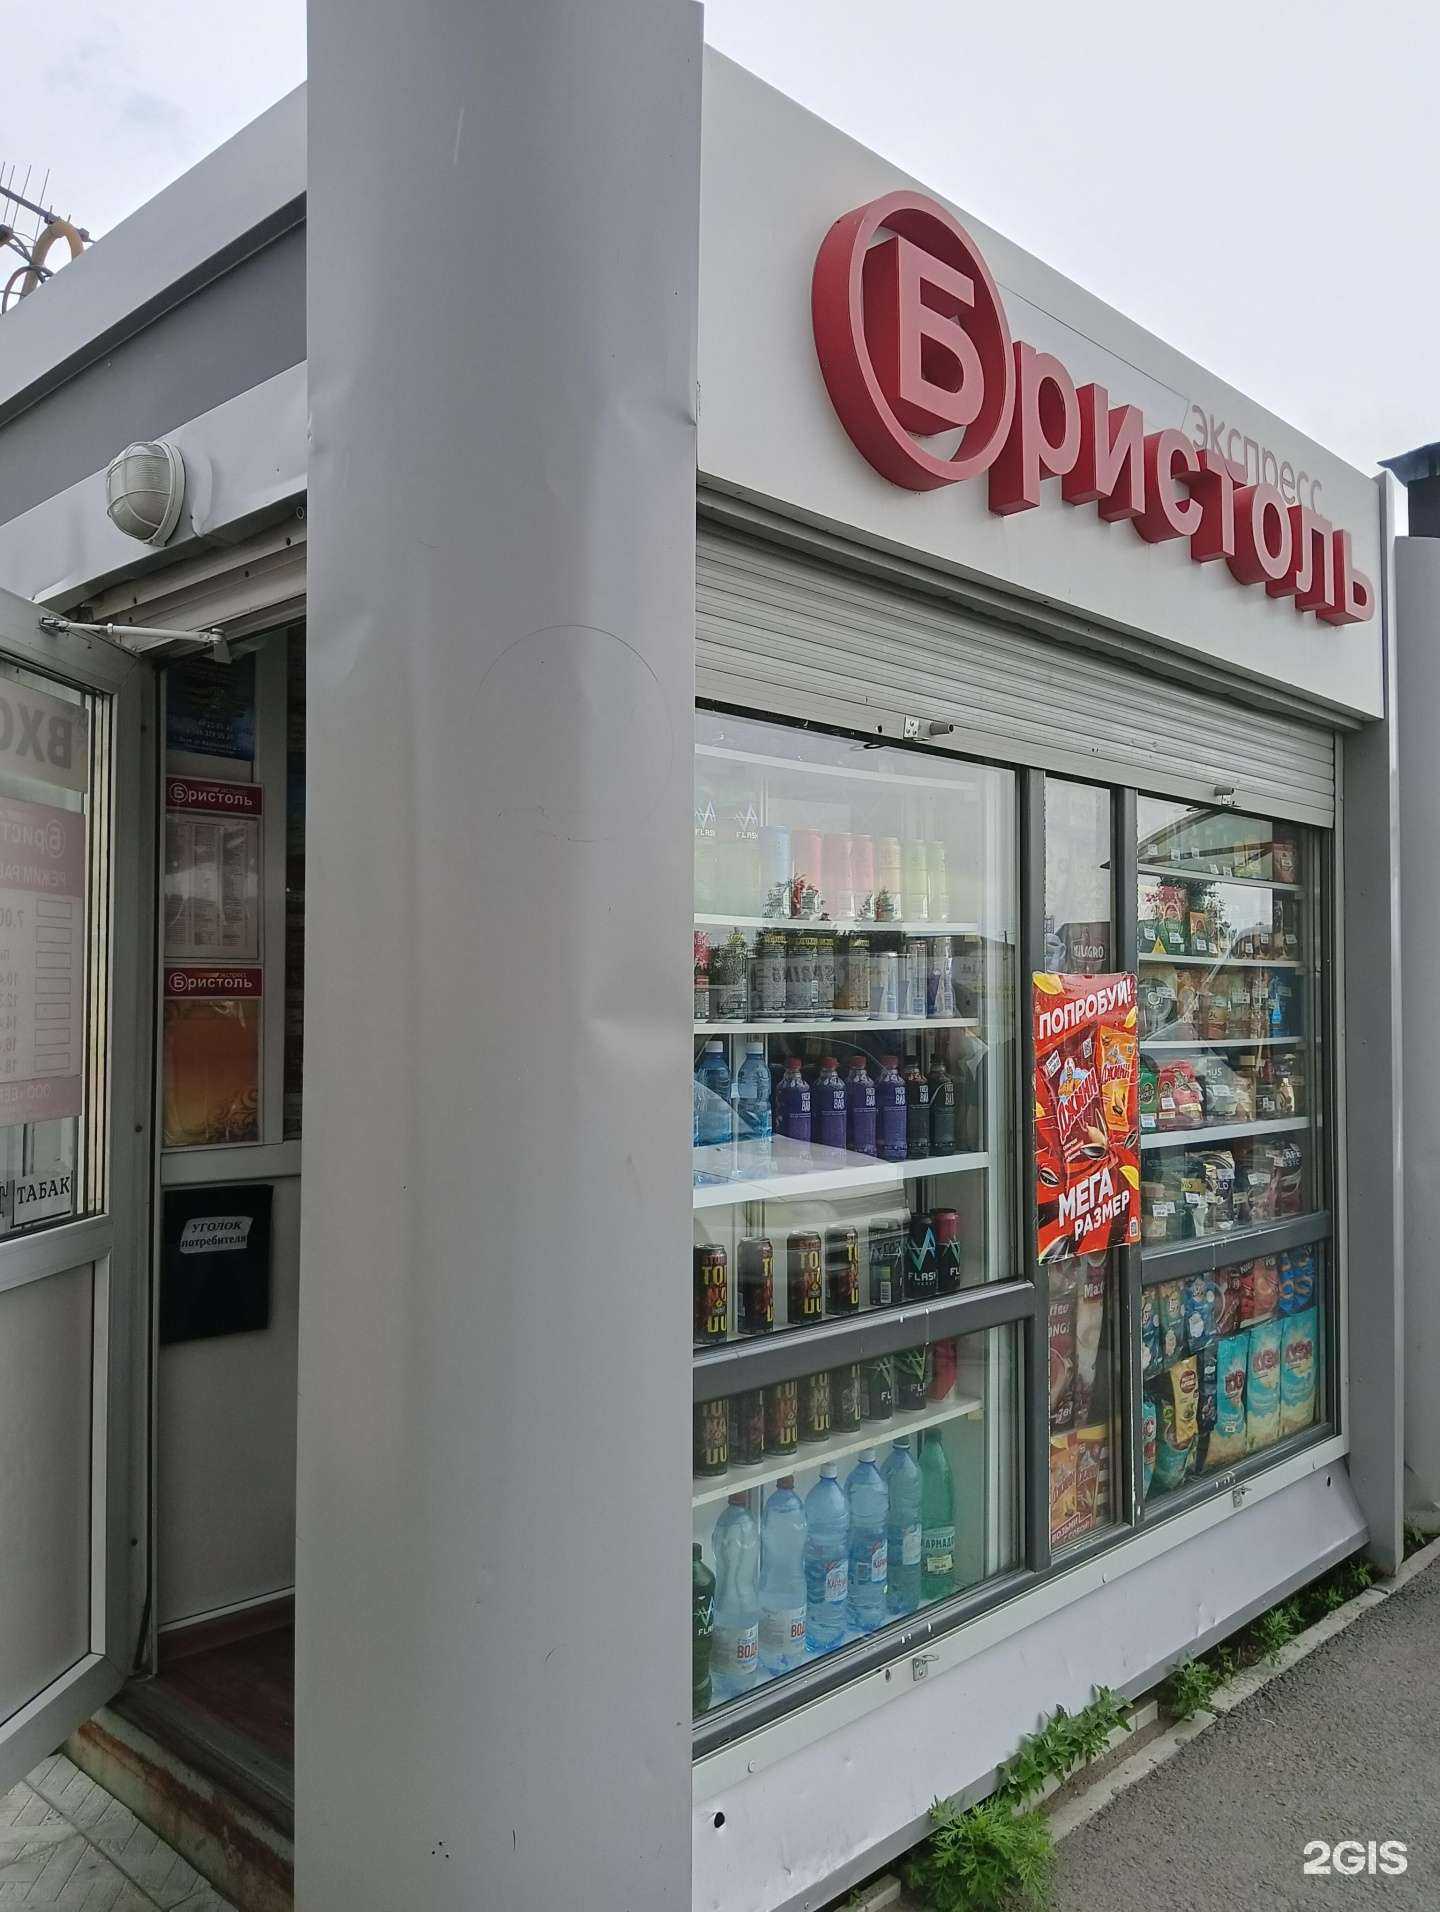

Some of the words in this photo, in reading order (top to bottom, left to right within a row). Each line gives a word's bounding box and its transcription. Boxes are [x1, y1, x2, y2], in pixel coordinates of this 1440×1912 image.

[811, 190, 1376, 626] Бристоль
[1192, 404, 1323, 514] экспресс
[169, 782, 253, 806] Бристоль
[169, 972, 253, 991] Бристоль
[1039, 978, 1132, 1040] ПОПРОБУЙ!
[17, 1176, 71, 1205] ТАБАК
[1058, 1167, 1114, 1228] МЕГА
[191, 1221, 242, 1233] УГОЛОК
[1074, 1190, 1130, 1242] РАЗМЕР
[181, 1234, 248, 1249] потребителя
